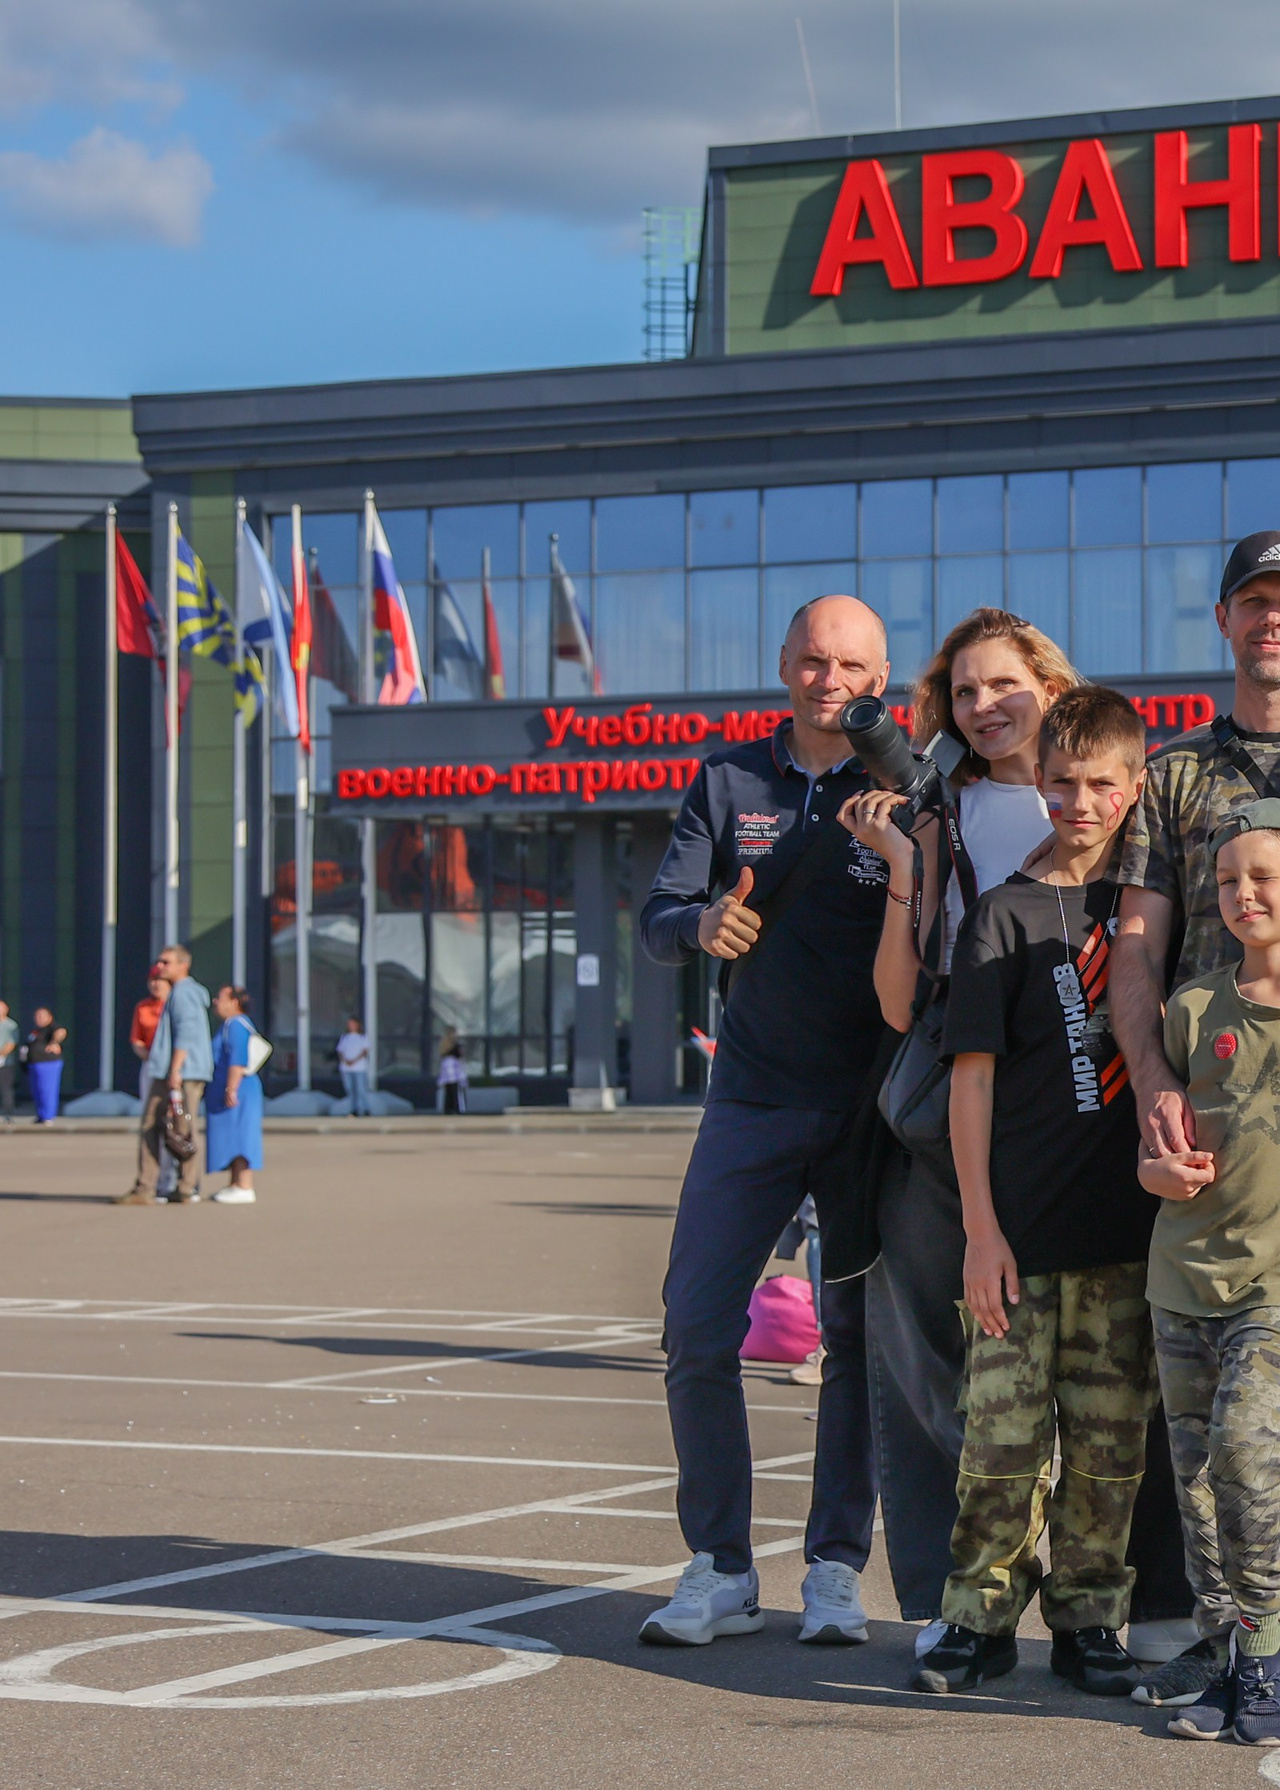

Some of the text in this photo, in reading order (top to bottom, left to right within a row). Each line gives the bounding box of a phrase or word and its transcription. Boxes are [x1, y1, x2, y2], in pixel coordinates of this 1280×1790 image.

[1129, 693, 1216, 733] нтр
[735, 830, 780, 838] FOOTBALL TEAM
[948, 818, 961, 851] EOS R
[1072, 1055, 1101, 1113] МИР
